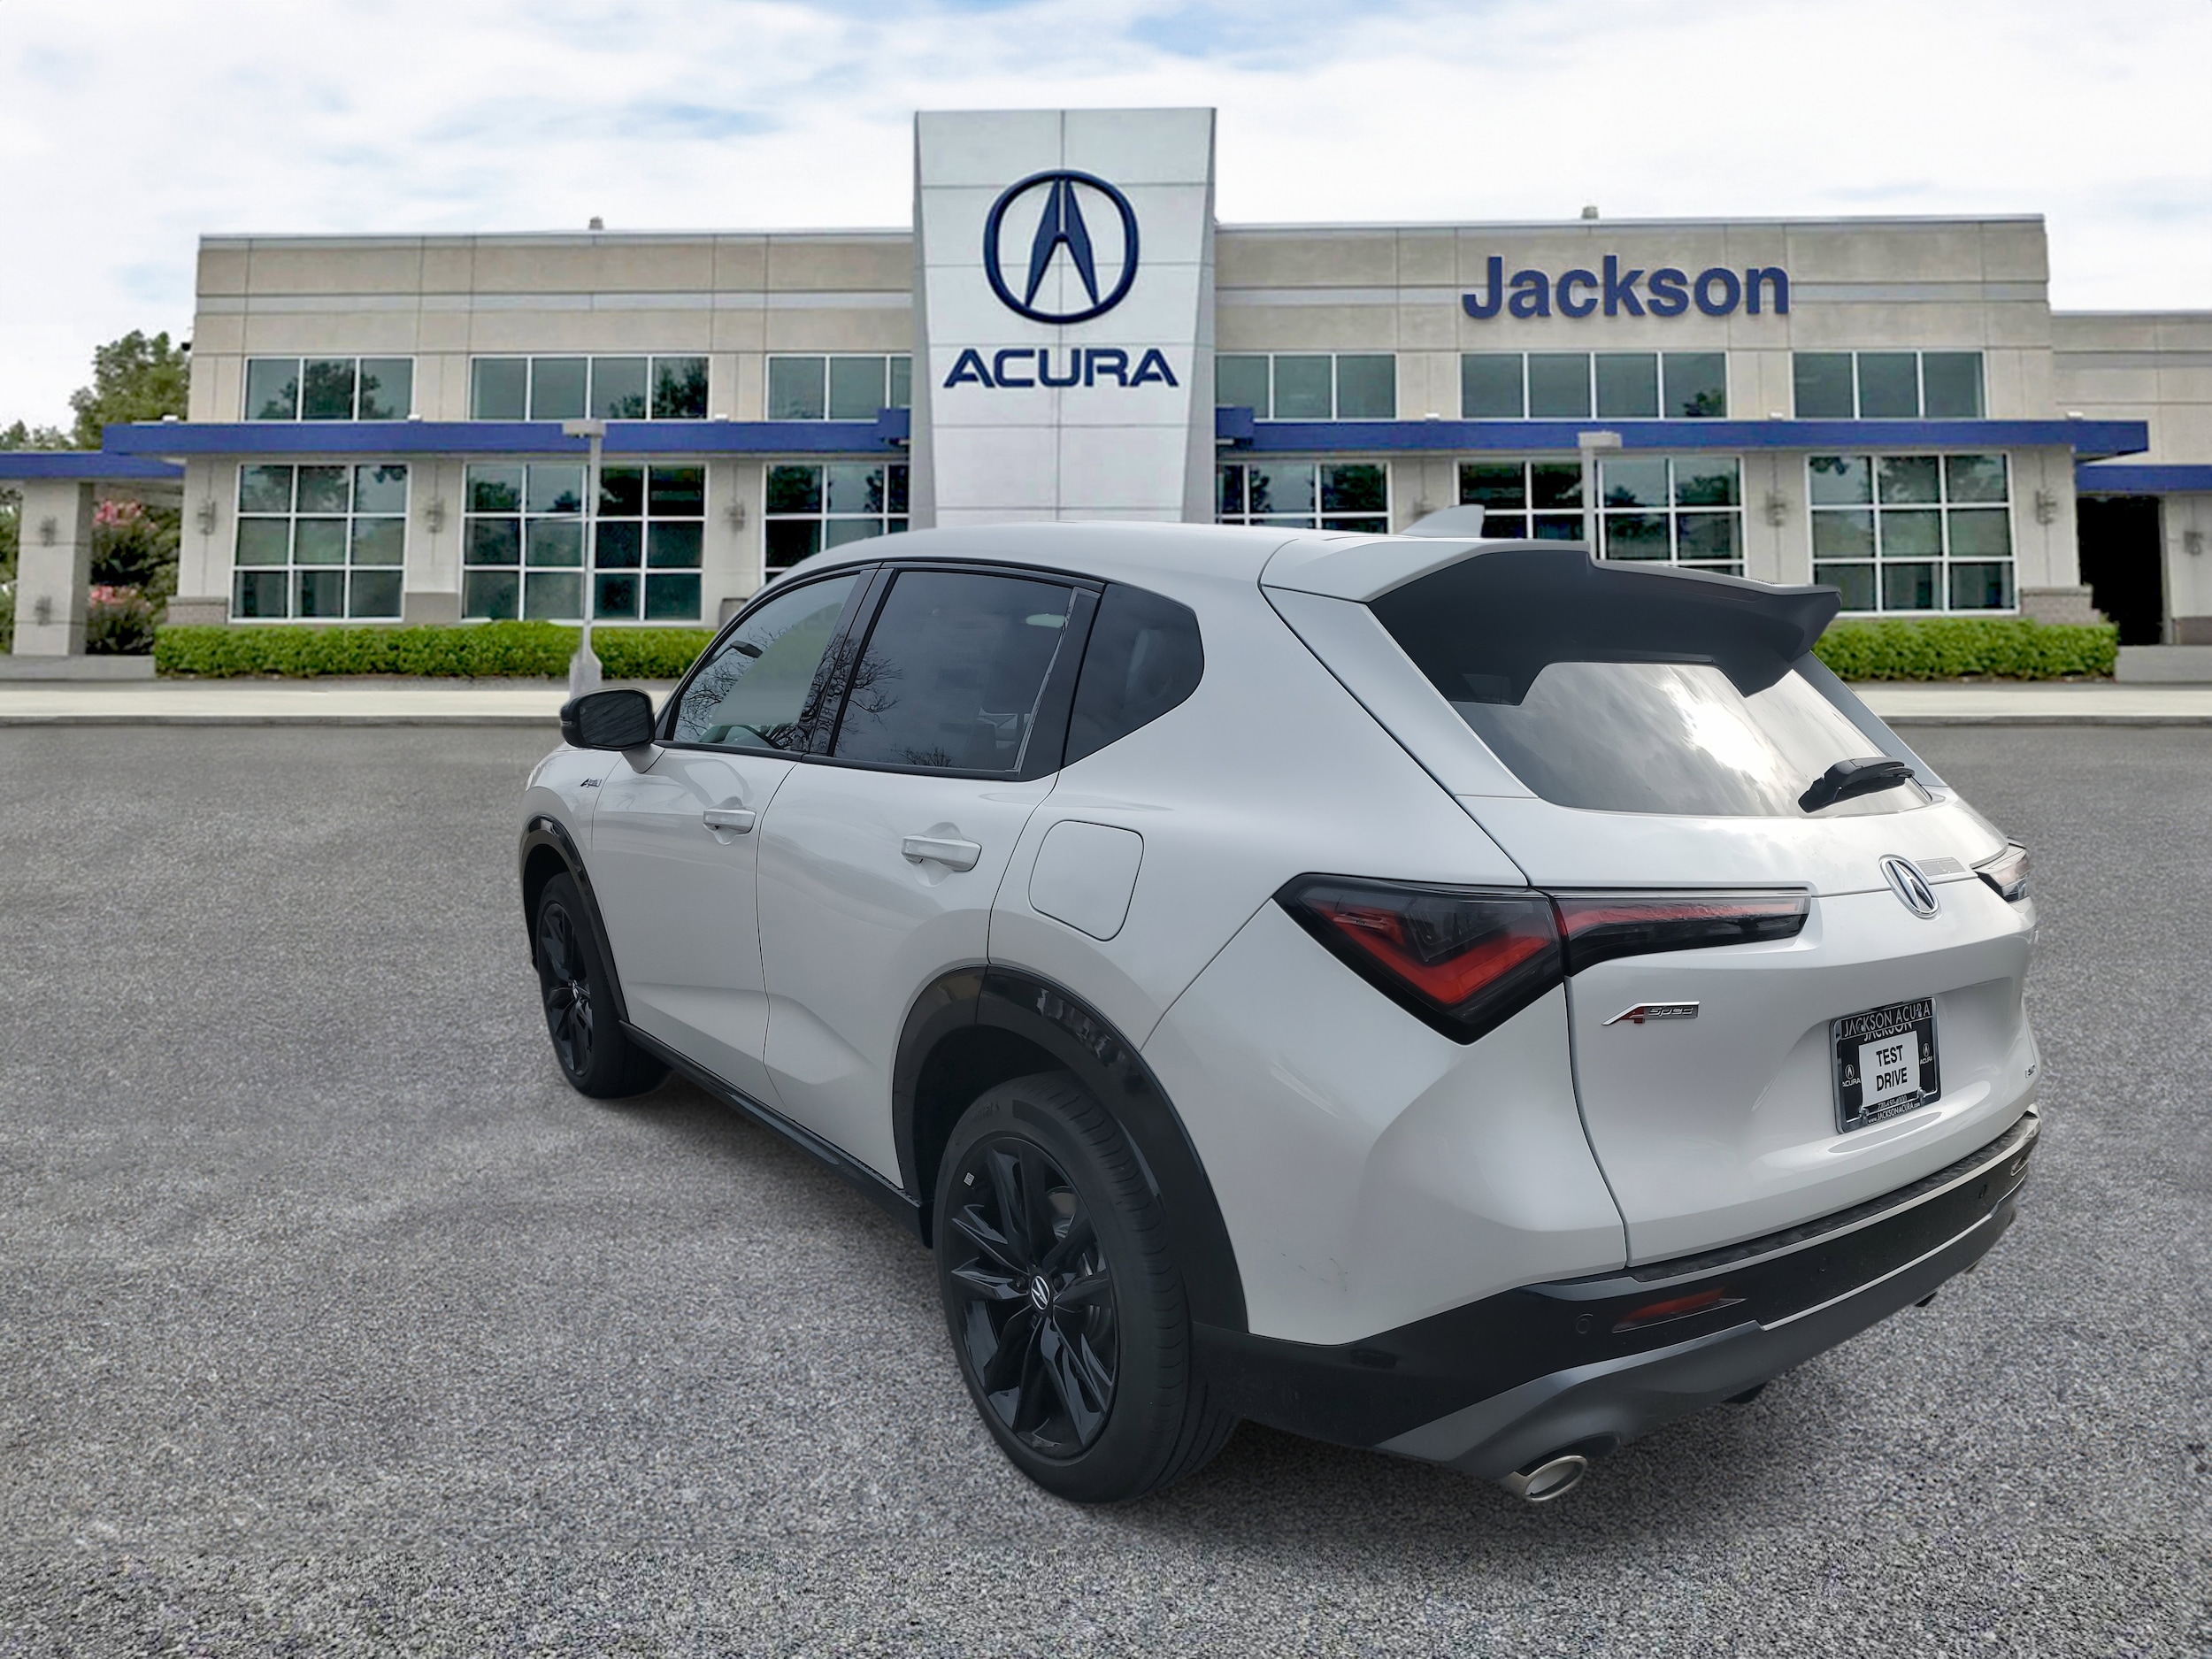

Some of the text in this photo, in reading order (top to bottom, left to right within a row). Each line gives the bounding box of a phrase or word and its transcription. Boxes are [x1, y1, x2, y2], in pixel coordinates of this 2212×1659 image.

[1463, 255, 1790, 319] Jackson
[943, 348, 1179, 388] ACURA
[1844, 1001, 1931, 1037] JACKSON ACURA
[1876, 1044, 1903, 1067] TEST
[1876, 1067, 1908, 1092] DRIVE
